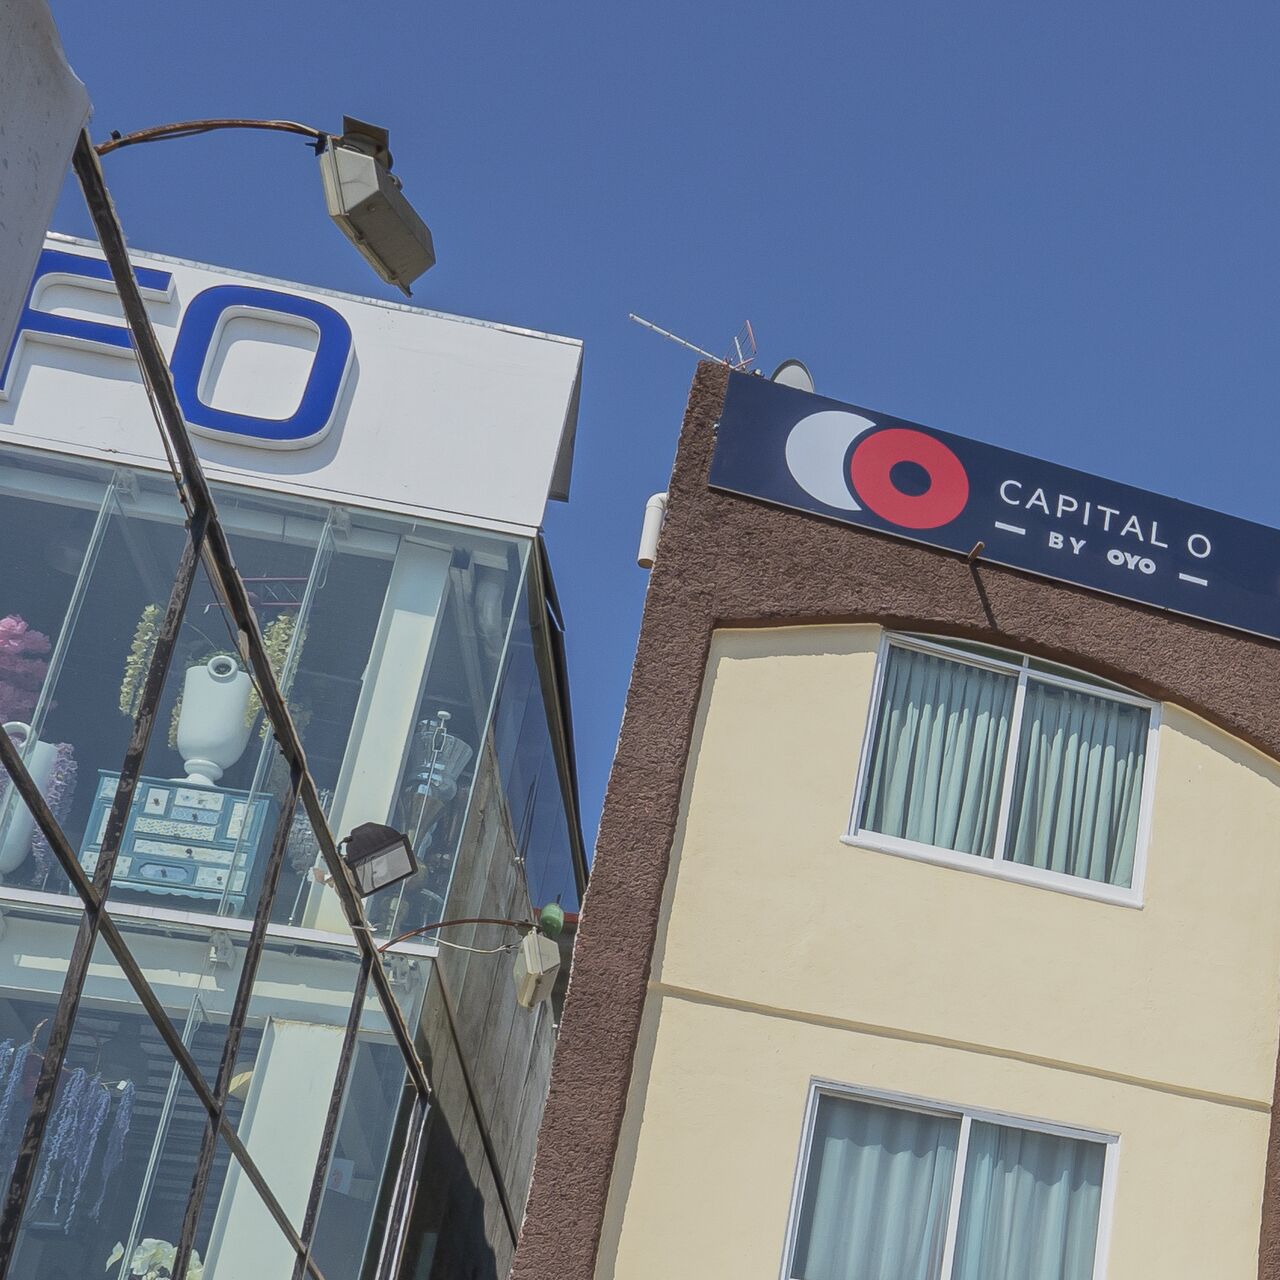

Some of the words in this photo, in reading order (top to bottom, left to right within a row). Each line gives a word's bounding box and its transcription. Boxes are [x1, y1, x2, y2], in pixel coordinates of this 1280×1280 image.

[1000, 480, 1168, 548] CAPITAL
[1187, 533, 1212, 559] O
[1049, 531, 1086, 555] BY
[1107, 549, 1156, 574] OYO
